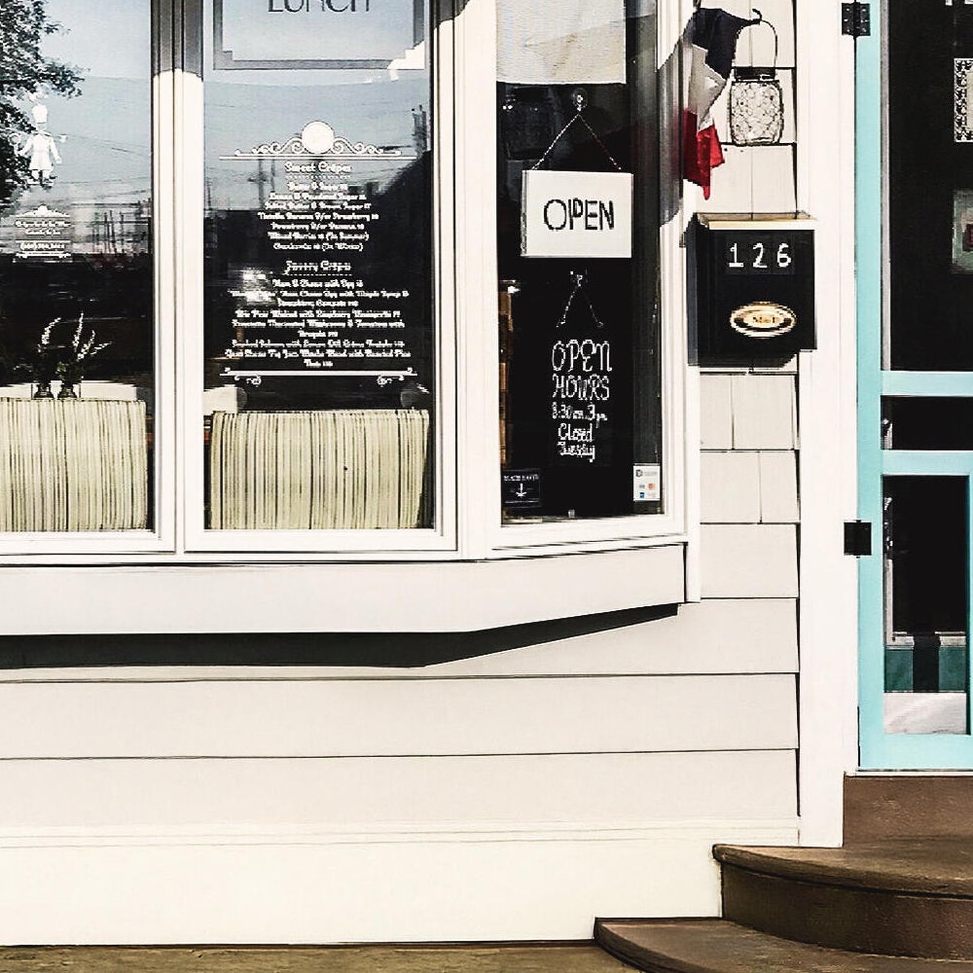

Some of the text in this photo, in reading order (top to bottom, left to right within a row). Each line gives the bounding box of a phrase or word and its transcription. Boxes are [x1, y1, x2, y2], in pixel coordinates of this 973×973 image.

[284, 161, 316, 174] Sweet
[543, 197, 615, 231] OPEN
[728, 242, 792, 268] 126
[552, 339, 612, 372] OPEN
[552, 373, 610, 400] HOURS
